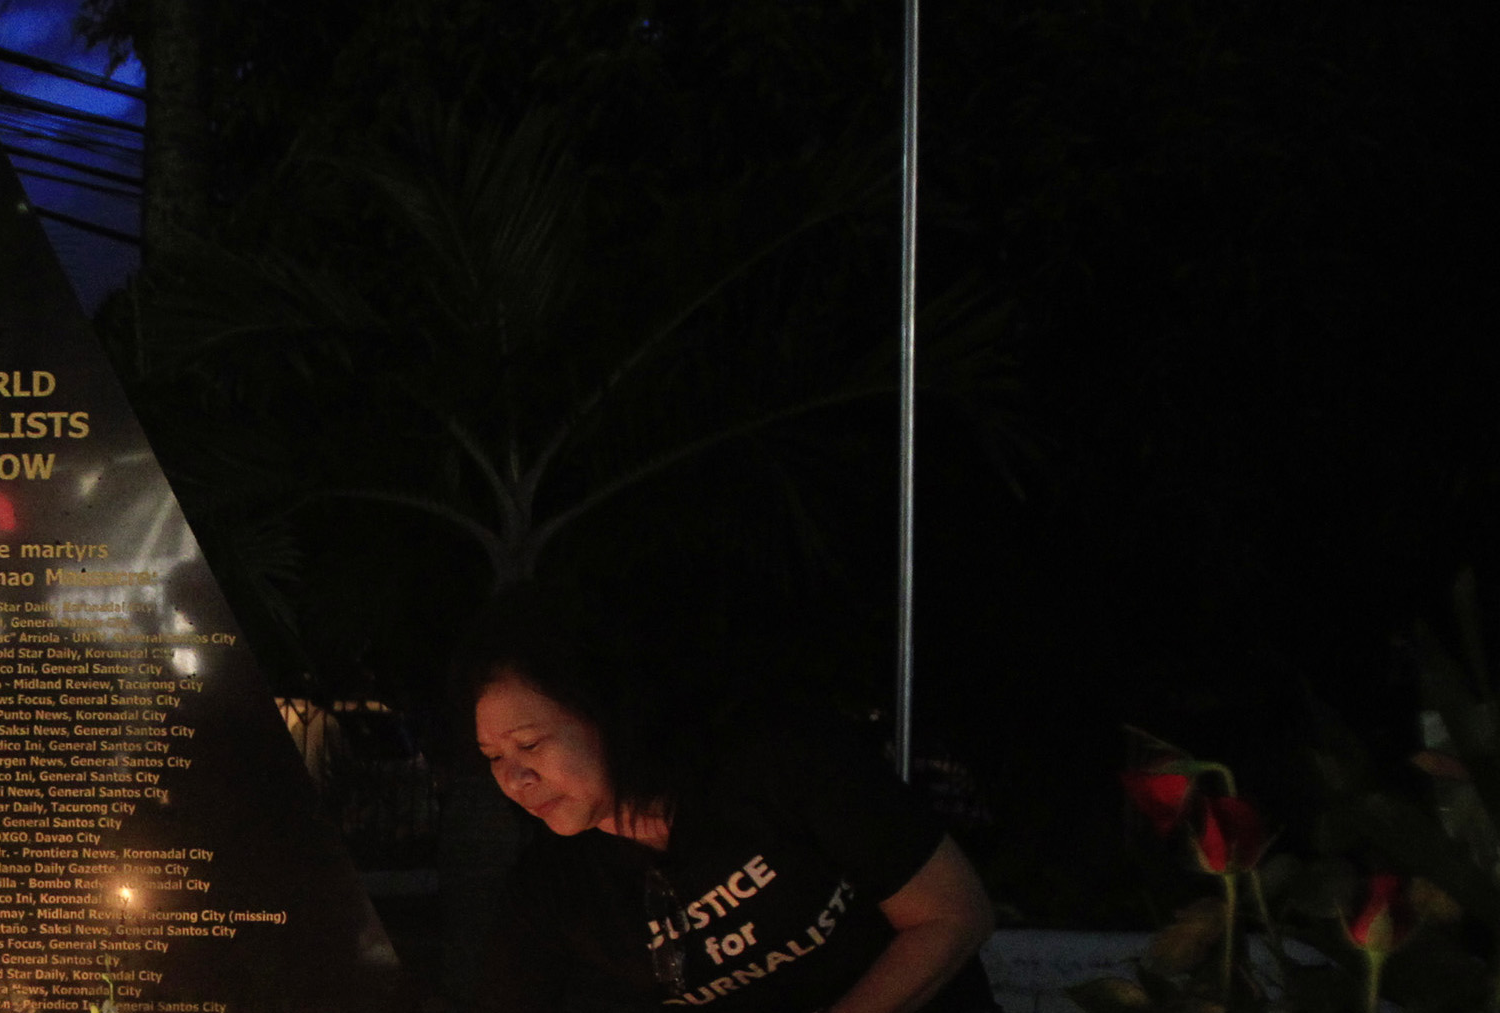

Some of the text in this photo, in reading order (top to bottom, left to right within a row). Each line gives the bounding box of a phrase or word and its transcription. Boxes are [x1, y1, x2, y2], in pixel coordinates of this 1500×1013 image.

[21, 541, 109, 562] martyrs
[19, 649, 43, 660] Star
[42, 664, 90, 675] General
[93, 664, 133, 675] Santos
[139, 664, 162, 678] City
[14, 679, 62, 690] Midland
[118, 679, 176, 693] Tacurong
[179, 679, 204, 693] City
[60, 695, 108, 706] General
[111, 695, 152, 706] Santos
[156, 695, 180, 709] City
[75, 710, 139, 721] Koronadal
[143, 710, 166, 724] City
[74, 726, 121, 737] General
[127, 726, 167, 737] Santos
[171, 726, 196, 740] City
[49, 741, 97, 752] General
[101, 741, 141, 752] Santos
[146, 741, 170, 755] City
[71, 756, 119, 767] General
[123, 756, 164, 768] Santos
[167, 757, 192, 771] City
[39, 771, 86, 782] General
[91, 771, 132, 783] Santos
[135, 772, 160, 786] City
[49, 786, 96, 797] General
[99, 786, 141, 798] Santos
[144, 787, 170, 801] City
[52, 801, 108, 815] Tacurong
[112, 802, 136, 816] City
[2, 816, 49, 827] General
[53, 816, 94, 828] Santos
[98, 817, 122, 831] City
[35, 832, 72, 844] Davao
[77, 833, 101, 847] City
[23, 847, 79, 859] Prontiera
[122, 848, 187, 859] Koronadal
[189, 849, 215, 863] City
[35, 863, 64, 877] Daily
[165, 864, 188, 878] City
[37, 908, 85, 919] Midland
[201, 909, 226, 923] City
[229, 910, 288, 924] (missing)
[40, 923, 71, 934] Saksi
[117, 924, 164, 935] General
[167, 924, 209, 935] Santos
[211, 924, 236, 938] City
[49, 938, 97, 949] General
[101, 939, 141, 950] Santos
[144, 939, 169, 953] City
[704, 921, 758, 965] for
